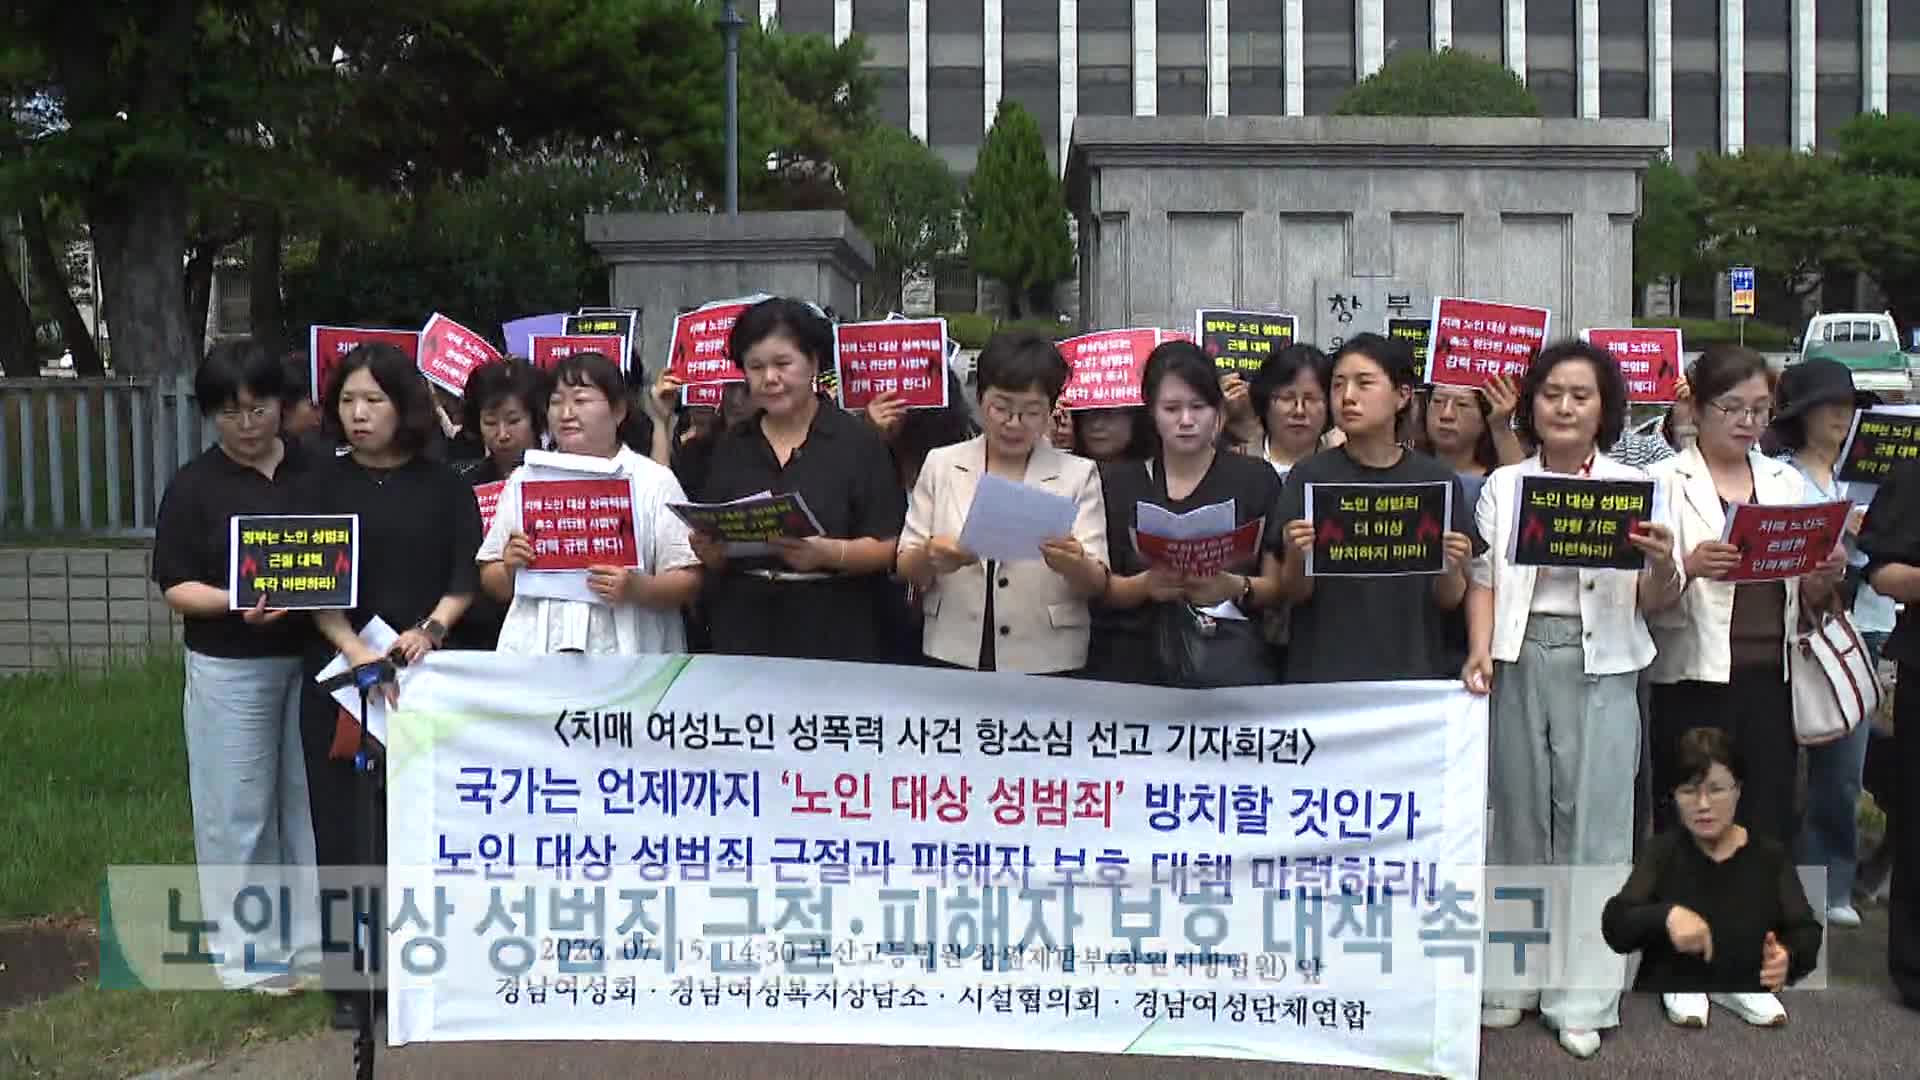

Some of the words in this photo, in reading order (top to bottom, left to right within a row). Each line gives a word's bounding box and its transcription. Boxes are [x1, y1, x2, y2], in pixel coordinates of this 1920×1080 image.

[1340, 495, 1369, 512] 노인
[1374, 495, 1419, 512] 성범죄
[1530, 490, 1561, 508] 노인
[1565, 492, 1595, 509] 대상
[1600, 494, 1644, 511] 성범죄
[282, 529, 308, 545] 노인
[311, 529, 350, 545] 성범죄
[1373, 519, 1403, 537] 이상
[1329, 543, 1388, 561] 방치하지
[646, 711, 775, 750] 여성노인
[788, 714, 884, 752] 성폭력
[897, 715, 962, 756] 사건
[975, 718, 1073, 757] 항소심
[1087, 720, 1153, 759] 선고
[455, 766, 581, 815] 국가는
[597, 766, 760, 818] 언제까지
[891, 774, 973, 824] 대상
[1145, 781, 1273, 836] 방치할
[1288, 787, 1422, 841] 것인가
[433, 832, 516, 880] 노인
[535, 833, 617, 882] 대상
[631, 833, 753, 883] 성범죄
[769, 836, 896, 886] 근절과
[910, 841, 1035, 890] 피해자
[1047, 847, 1132, 890] 보호
[1150, 851, 1234, 900] 대책
[1252, 855, 1437, 908] 마련하라!
[541, 937, 612, 962] 2026.
[724, 938, 796, 964] 14:30
[495, 975, 637, 1008] 경남여성회
[669, 976, 929, 1009] 경남여성복지상담소
[957, 983, 1100, 1019] 시설협의회
[1134, 989, 1372, 1029] 경남여성단체연합
